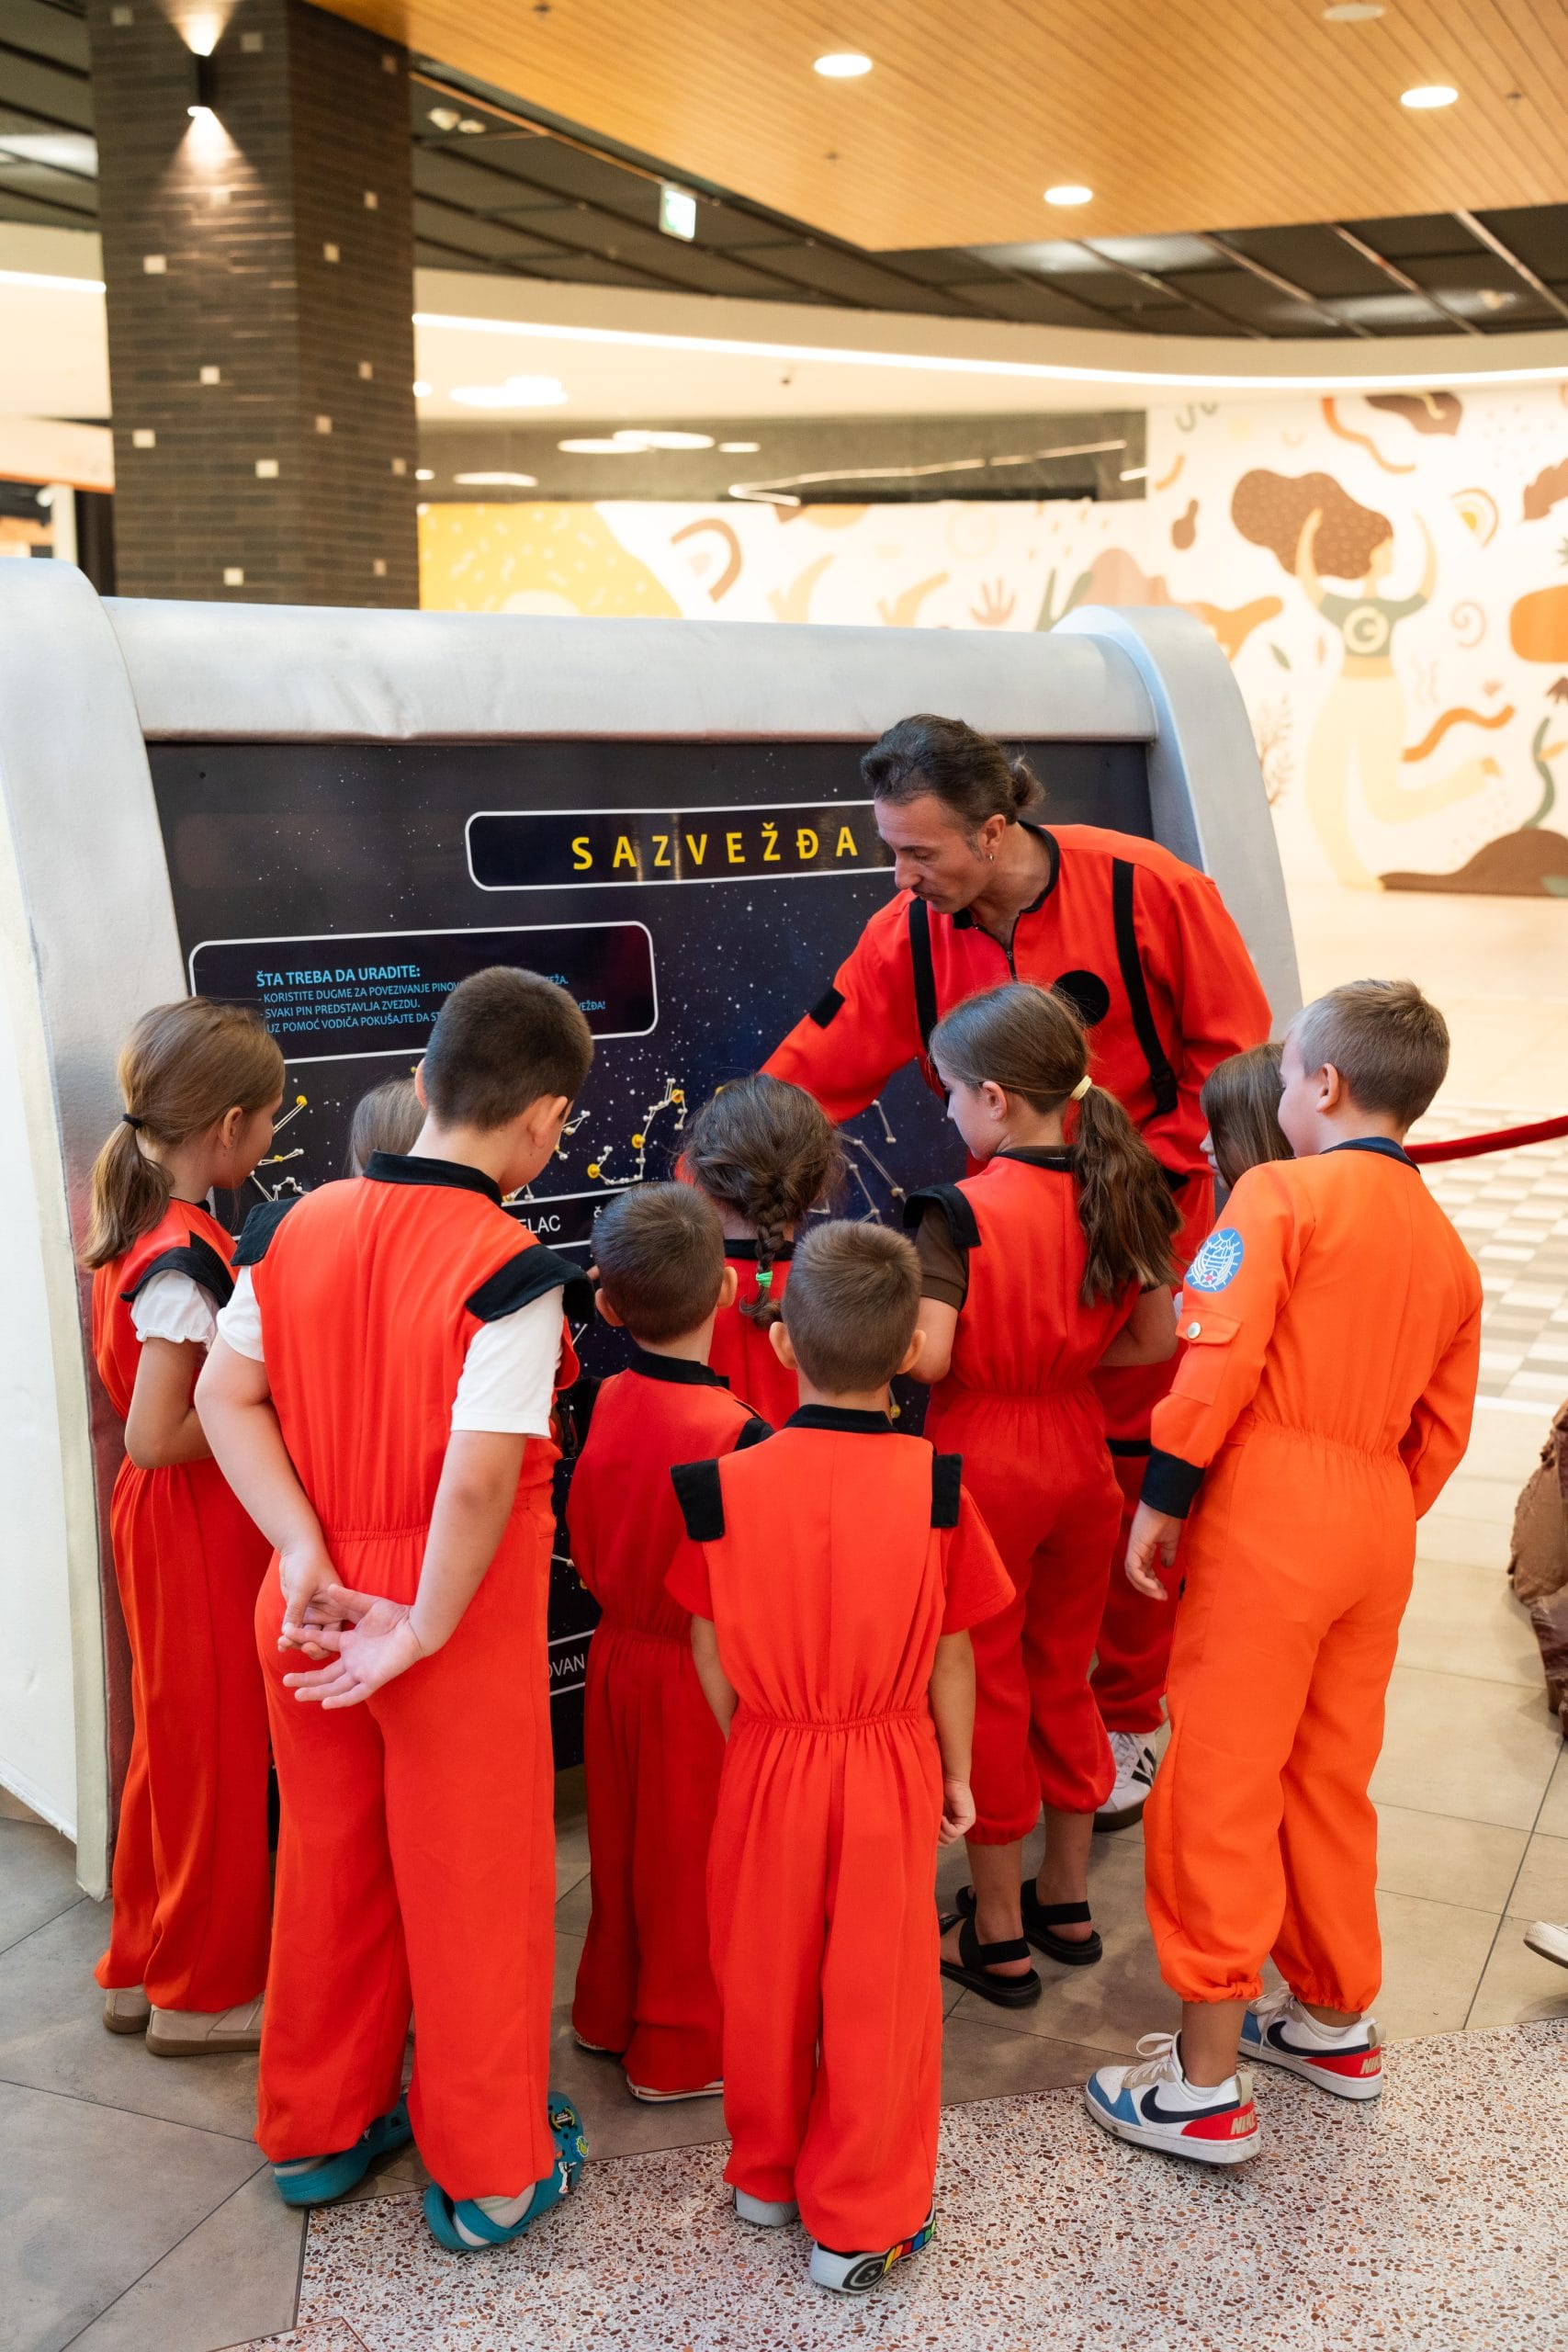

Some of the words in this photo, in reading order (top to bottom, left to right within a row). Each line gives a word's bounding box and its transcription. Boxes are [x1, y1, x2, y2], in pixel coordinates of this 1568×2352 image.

[571, 821, 858, 870] SAZVEŽĐA
[256, 970, 284, 987] ŠTA
[286, 969, 333, 985] TREBA
[335, 968, 355, 982] DA
[358, 965, 421, 980] URADITE:
[264, 990, 314, 1003] KORISTITE
[316, 988, 353, 1000] DUGME
[355, 987, 367, 997] ZA
[369, 982, 430, 996] POVEZIVANJE
[265, 1007, 293, 1019] SVAKI
[296, 1005, 312, 1016] PIN
[315, 1001, 380, 1014] PREDSTAVLJA
[382, 999, 421, 1011] ZVEZDU.
[266, 1023, 280, 1034] UZ
[283, 1018, 320, 1032] POMOĆ
[321, 1015, 359, 1029] VODIČA
[361, 1012, 415, 1027] POKUŠAJTE
[416, 1012, 429, 1023] DA
